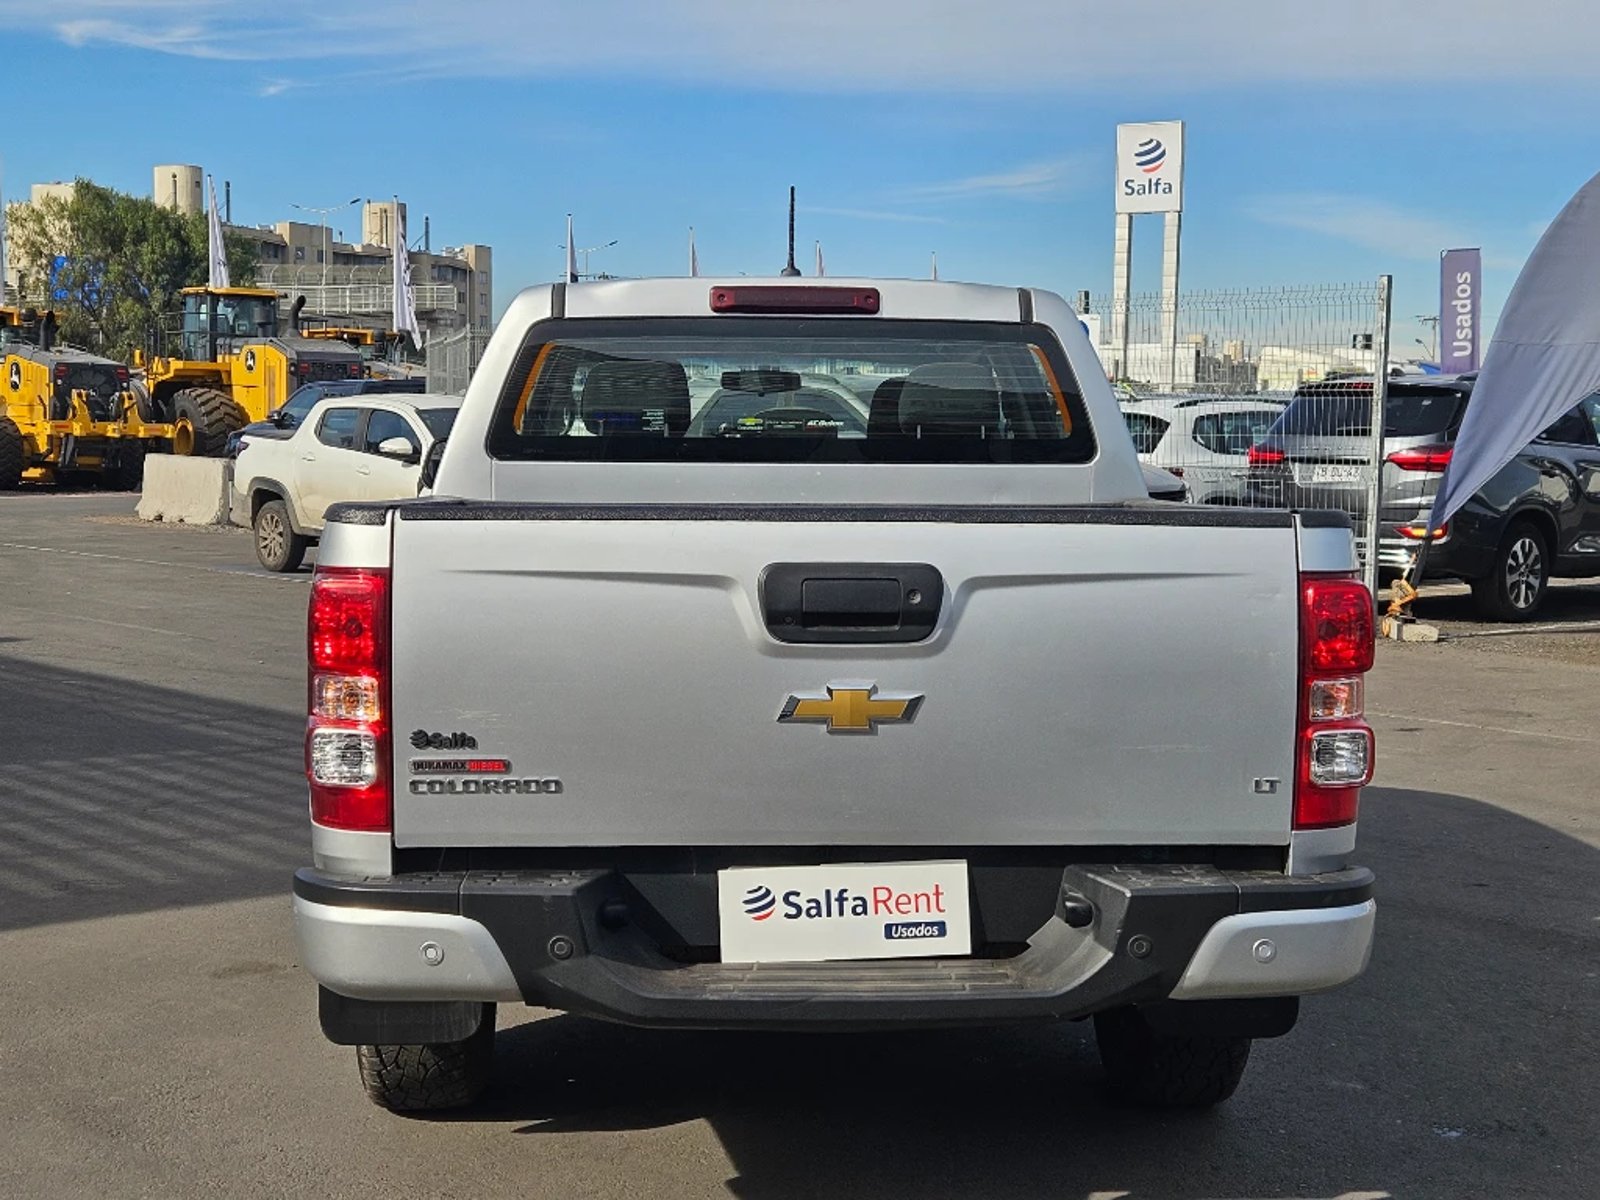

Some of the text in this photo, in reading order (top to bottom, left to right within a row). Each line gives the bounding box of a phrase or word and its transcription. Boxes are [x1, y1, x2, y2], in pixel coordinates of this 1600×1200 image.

[1124, 177, 1173, 196] Salfa
[1451, 271, 1473, 358] Usados
[413, 760, 506, 772] DURAMAX DIESEL
[409, 778, 563, 794] COLORADO
[1253, 777, 1282, 794] LT
[782, 883, 946, 921] SalfaRent
[891, 923, 939, 938] Usados
